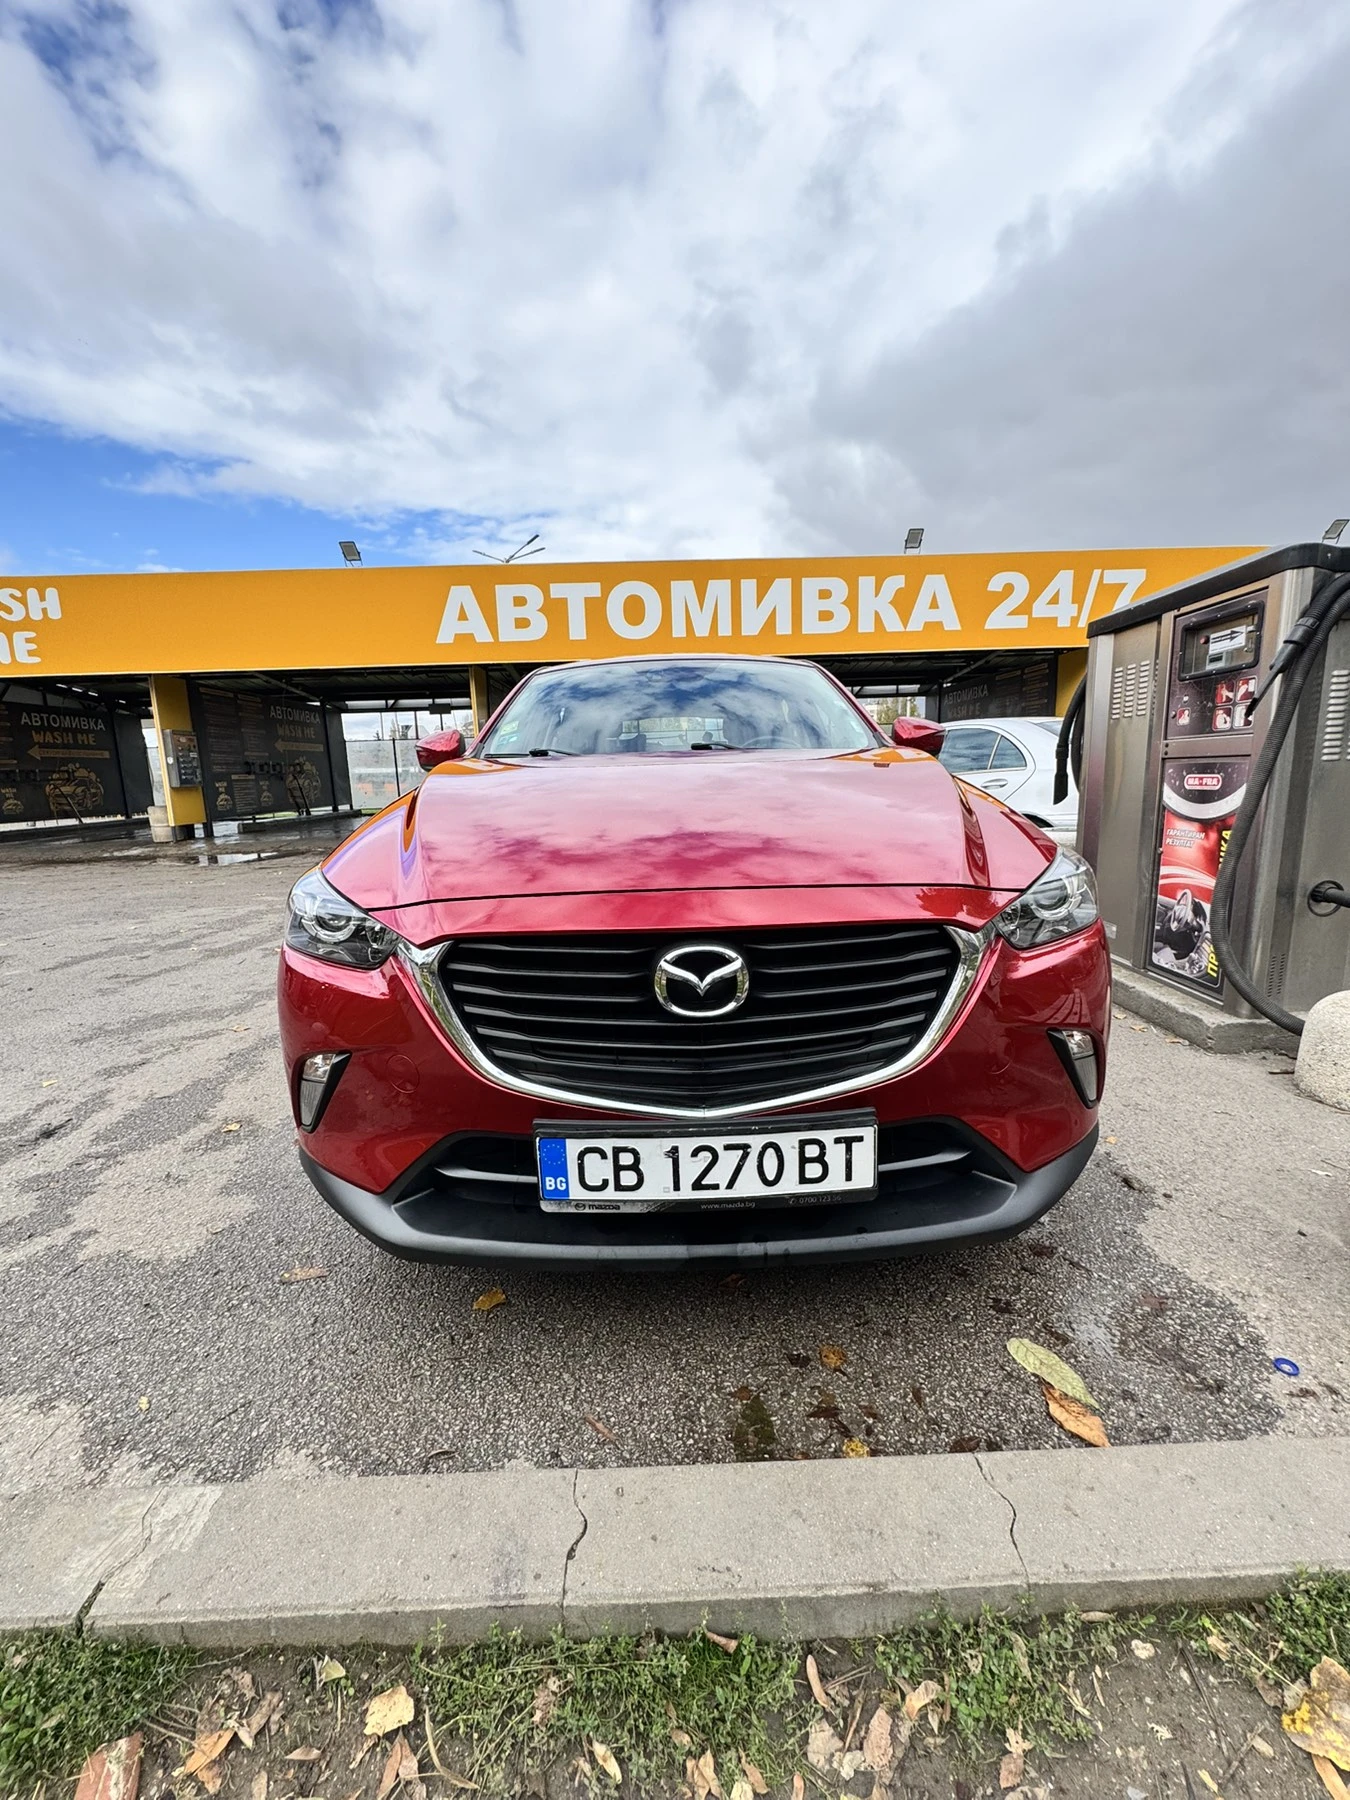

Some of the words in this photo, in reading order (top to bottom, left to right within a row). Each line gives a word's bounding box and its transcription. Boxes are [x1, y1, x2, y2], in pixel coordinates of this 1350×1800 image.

[435, 573, 962, 644] АВТОМИВКА
[984, 568, 1147, 629] 24/7
[21, 711, 106, 731] АВТОМИВКА
[269, 705, 321, 724] АВТОМИВКА
[31, 730, 73, 744] WASH
[1165, 837, 1195, 847] РЕЗУЛТАТ
[1166, 829, 1206, 840] ГАРАНТИРАН
[546, 1176, 567, 1191] BG
[577, 1146, 644, 1192] CB
[663, 1141, 785, 1192] 1270
[798, 1135, 864, 1185] BT
[700, 1201, 756, 1210] www.mazda.bg
